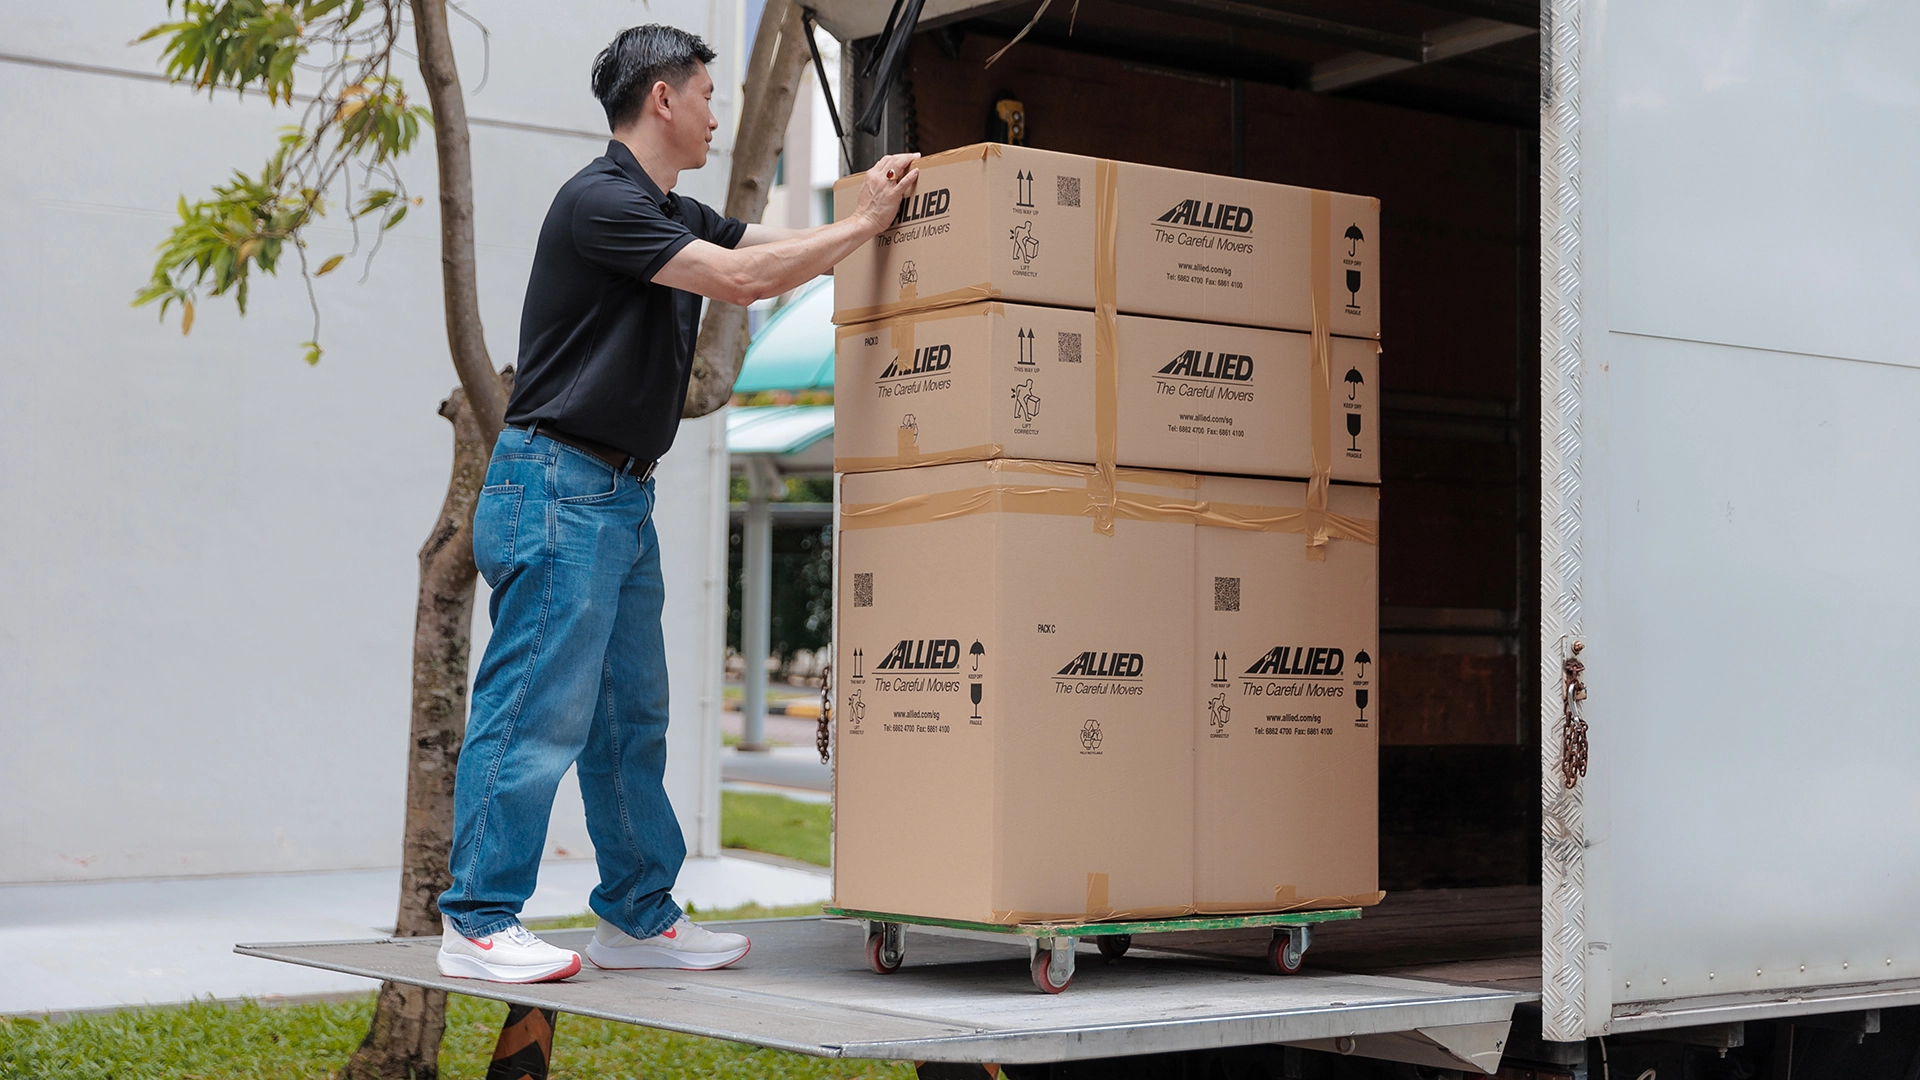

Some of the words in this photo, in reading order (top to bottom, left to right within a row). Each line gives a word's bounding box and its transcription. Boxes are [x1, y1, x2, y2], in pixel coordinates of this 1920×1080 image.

[1156, 199, 1253, 233] ALLIED
[877, 235, 892, 247] The
[893, 227, 920, 244] Careful
[922, 222, 951, 238] Movers
[1155, 229, 1174, 244] The
[1177, 232, 1215, 248] Careful
[1216, 238, 1253, 254] Movers
[1012, 270, 1038, 278] CORRECTLY
[1178, 262, 1232, 277] www.allied.com/sg
[1177, 274, 1190, 282] 6862
[1190, 276, 1203, 284] 4700
[1206, 278, 1216, 286] Fax:
[1231, 281, 1244, 289] 4100
[1345, 308, 1361, 316] FRAGILE
[864, 337, 875, 346] PACK
[1157, 350, 1254, 382] ALLIED
[878, 386, 892, 398] The
[894, 381, 922, 397] Careful
[922, 379, 952, 392] Movers
[1156, 381, 1176, 395] The
[1178, 384, 1216, 399] Careful
[1218, 386, 1254, 402] Movers
[1179, 414, 1232, 426] www.allied.com/sg
[1014, 428, 1039, 436] CORRECTLY
[1168, 424, 1178, 432] Tel:
[1178, 426, 1191, 434] 6862
[1192, 426, 1204, 434] 4700
[1206, 428, 1218, 436] Fax:
[1219, 428, 1230, 436] 6861
[1232, 430, 1244, 438] 4100
[1038, 624, 1051, 634] PACK
[1052, 624, 1056, 634] C
[876, 639, 960, 670] ALLIED
[1244, 646, 1344, 676] ALLIED
[1056, 652, 1144, 677] ALLIED
[875, 678, 891, 692] The
[893, 678, 925, 692] Careful
[926, 678, 960, 692] Movers
[1056, 682, 1072, 694] The
[1075, 682, 1108, 694] Careful
[1110, 684, 1144, 695] Movers
[1243, 682, 1262, 696] The
[1266, 682, 1304, 696] Careful
[1306, 684, 1344, 697] Movers
[893, 710, 940, 720] www.allied.com/sg
[1266, 714, 1322, 724] www.allied.com/sg
[884, 724, 892, 732] Tel:
[892, 724, 904, 732] 6862
[904, 724, 915, 732] 4700
[916, 724, 926, 732] Fax:
[939, 725, 950, 733] 4100
[1254, 727, 1264, 735] Tel:
